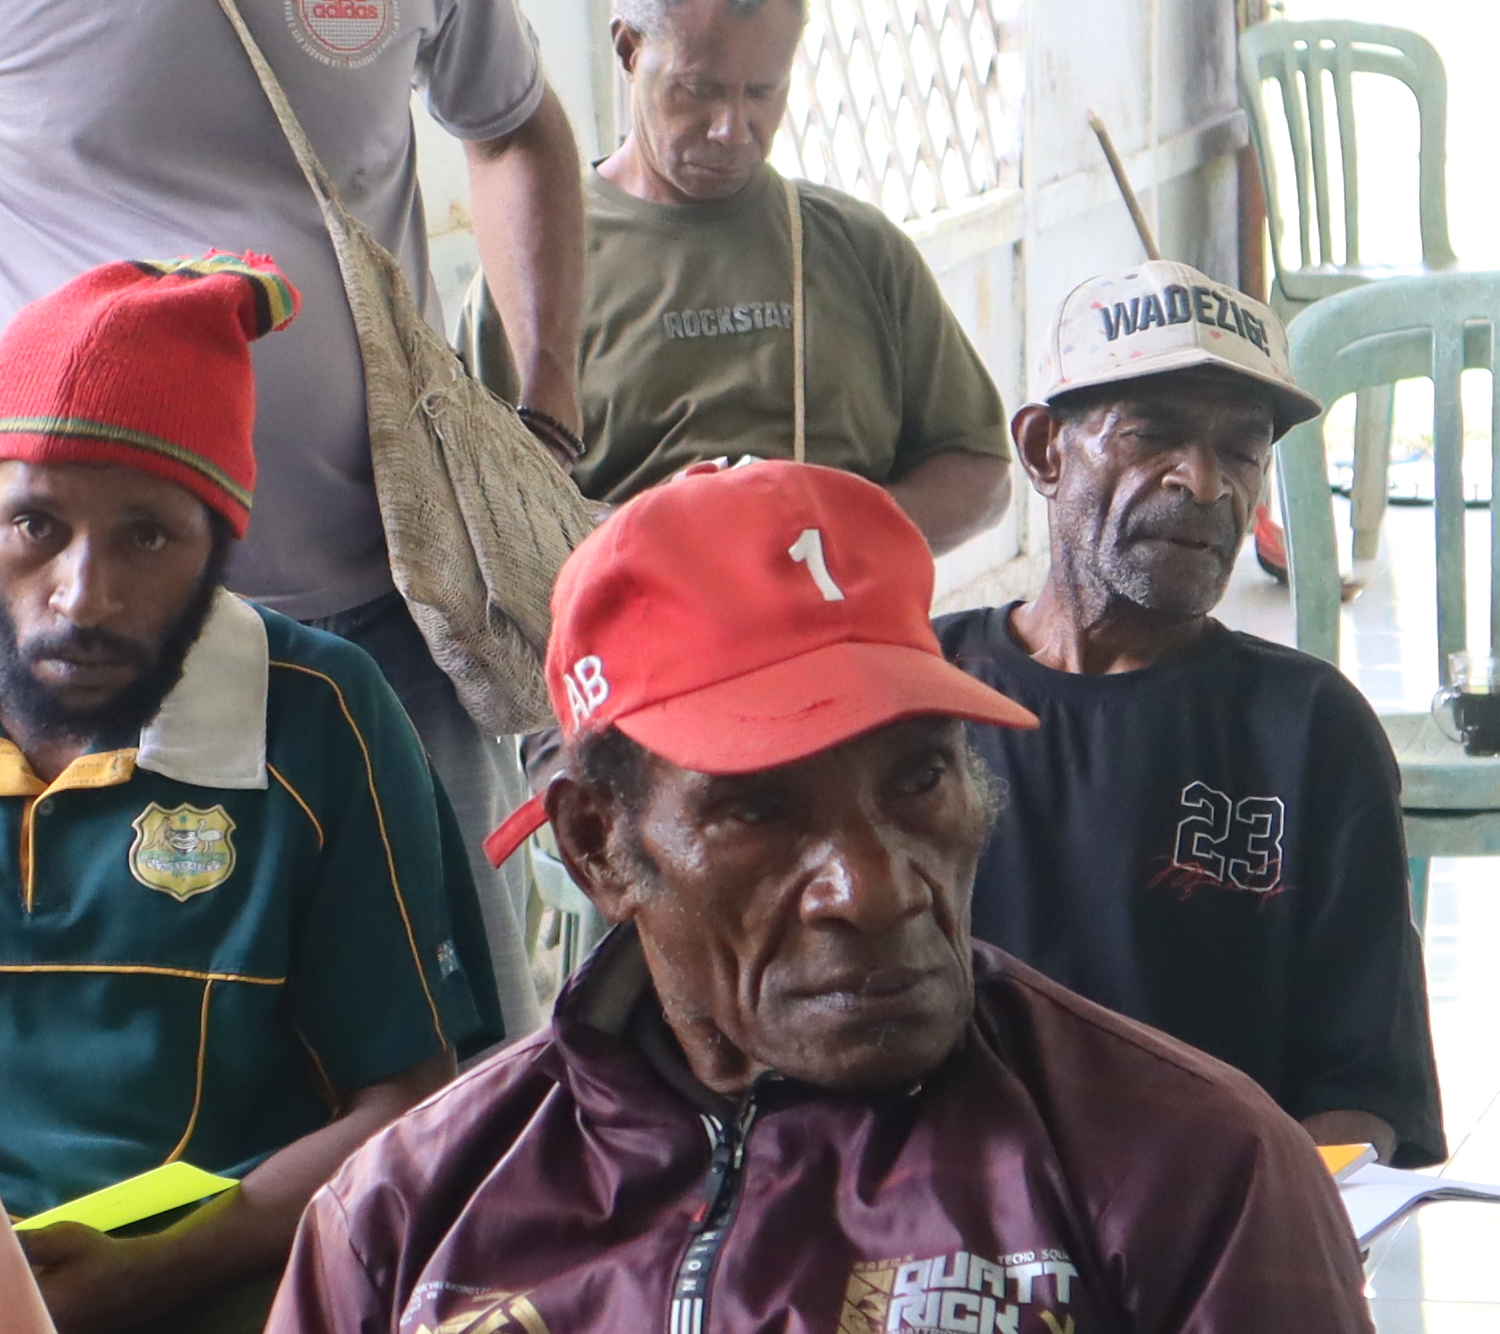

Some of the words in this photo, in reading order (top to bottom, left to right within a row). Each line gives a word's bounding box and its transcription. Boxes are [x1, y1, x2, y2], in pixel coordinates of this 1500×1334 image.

[312, 3, 378, 19] adidas
[1100, 284, 1270, 357] WADEZIG!
[788, 528, 845, 601] 1
[563, 655, 609, 734] AB
[1174, 780, 1284, 892] 23
[893, 1250, 1080, 1304] QUATT
